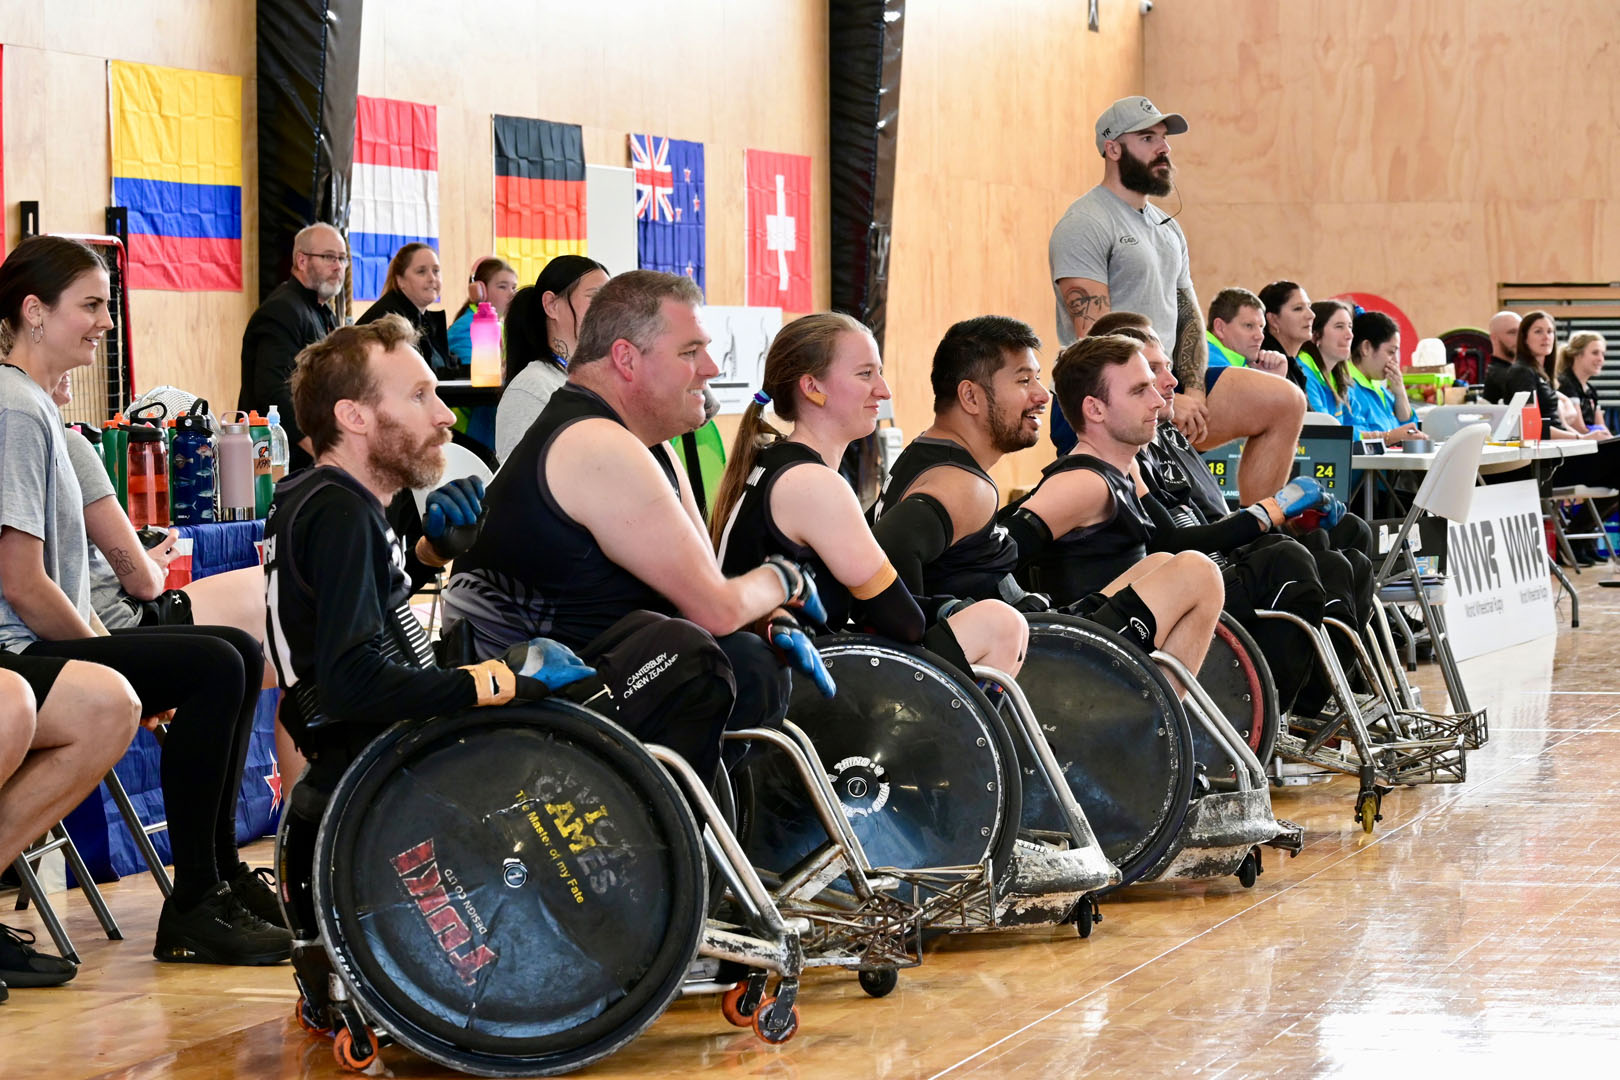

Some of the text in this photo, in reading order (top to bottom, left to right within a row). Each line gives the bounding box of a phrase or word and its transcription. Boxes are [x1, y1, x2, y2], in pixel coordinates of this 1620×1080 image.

[1208, 463, 1225, 475] 18
[1315, 465, 1334, 478] 24
[623, 653, 679, 699] OF NEW ZEALAND
[626, 652, 668, 686] CANTERBURY
[527, 811, 552, 847] Master
[556, 861, 571, 879] my
[567, 878, 584, 903] Fate
[389, 837, 498, 986] TUKI
[444, 868, 488, 935] DESIGN CO LTD
